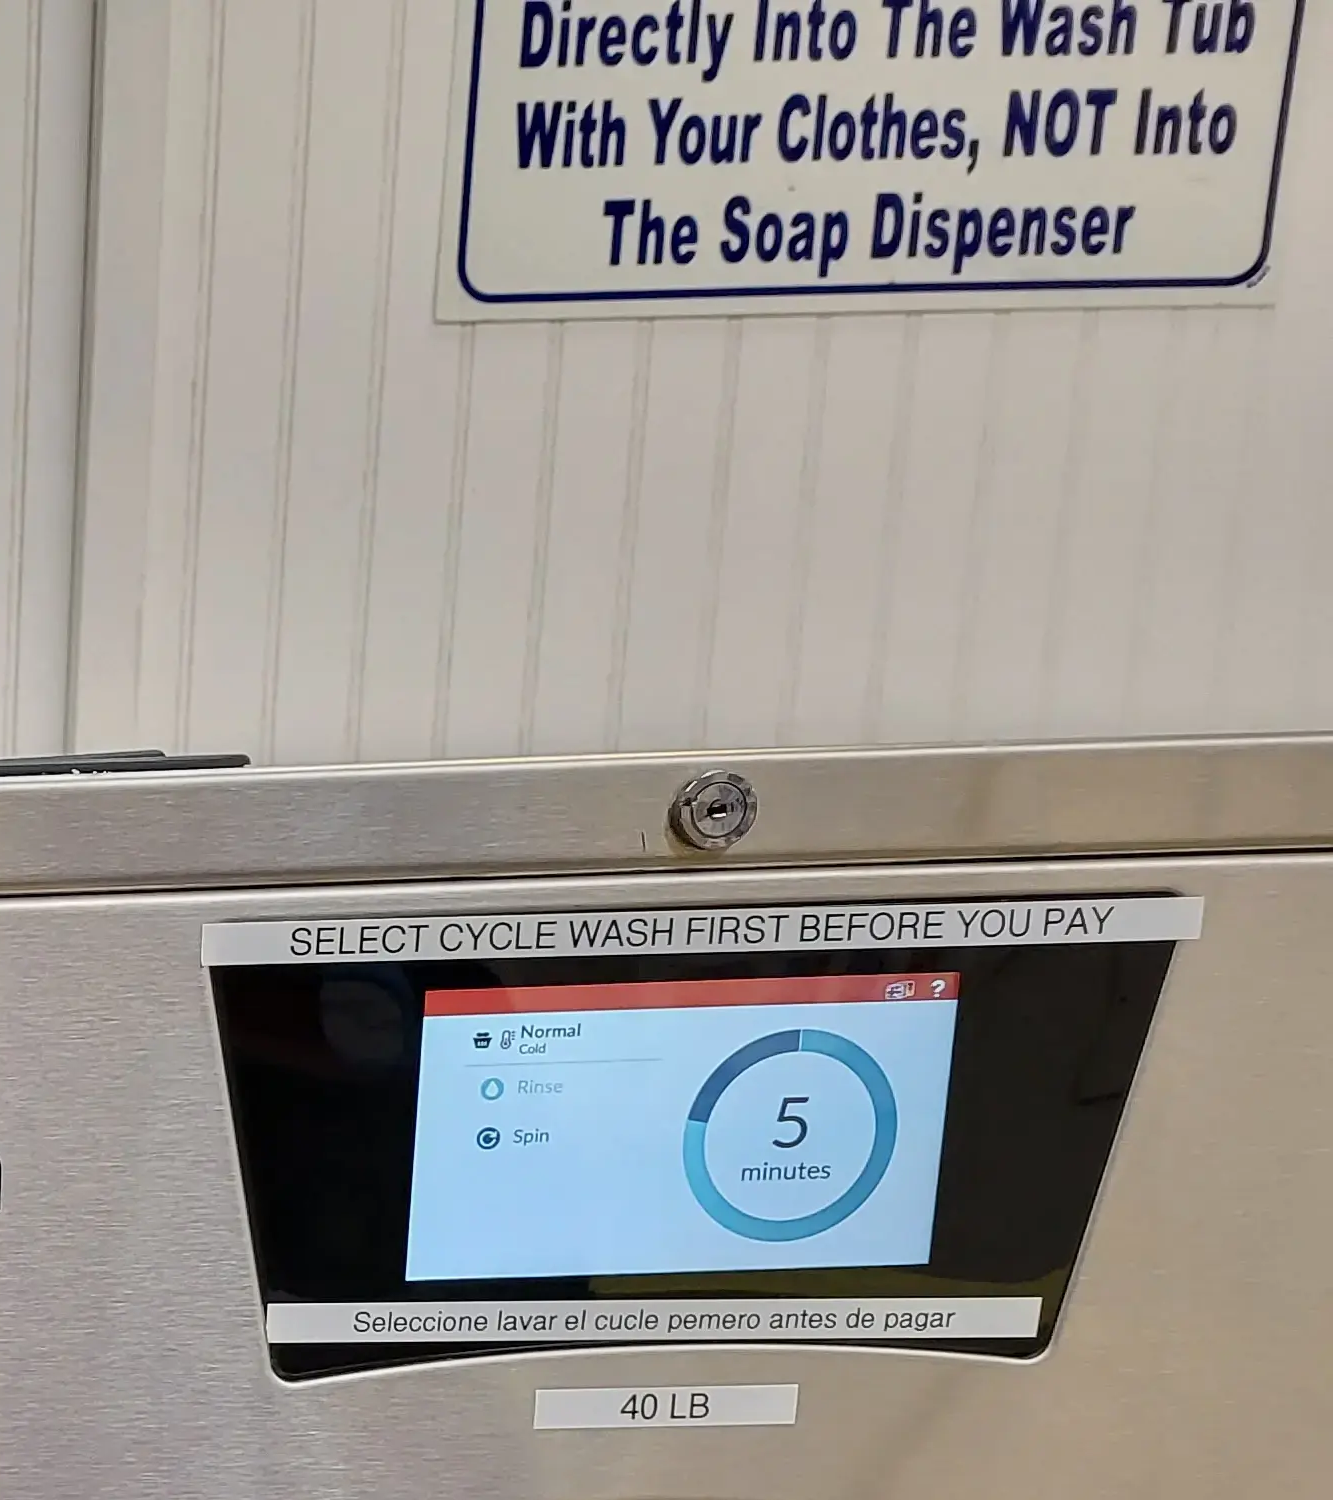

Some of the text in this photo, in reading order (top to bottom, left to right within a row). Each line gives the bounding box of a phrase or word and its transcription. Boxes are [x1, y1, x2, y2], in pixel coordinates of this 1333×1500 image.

[519, 0, 1256, 83] Directly Into The Wash Tub
[516, 88, 1236, 173] With Your Clothes, NOT Into
[603, 192, 1135, 277] The Soap Dispenser
[290, 905, 1117, 957] SELECT CYCLE WASH FIRST BEFORE YOU PAY
[521, 1023, 581, 1039] Normal
[519, 1043, 546, 1054] Cold
[518, 1080, 563, 1094] Rinse
[772, 1096, 811, 1149] 5
[513, 1128, 549, 1146] Spin
[741, 1159, 832, 1182] minutes
[353, 1307, 956, 1334] Seleccione lavar el cucle pemero antes de pagar
[621, 1393, 711, 1421] 40 LB
